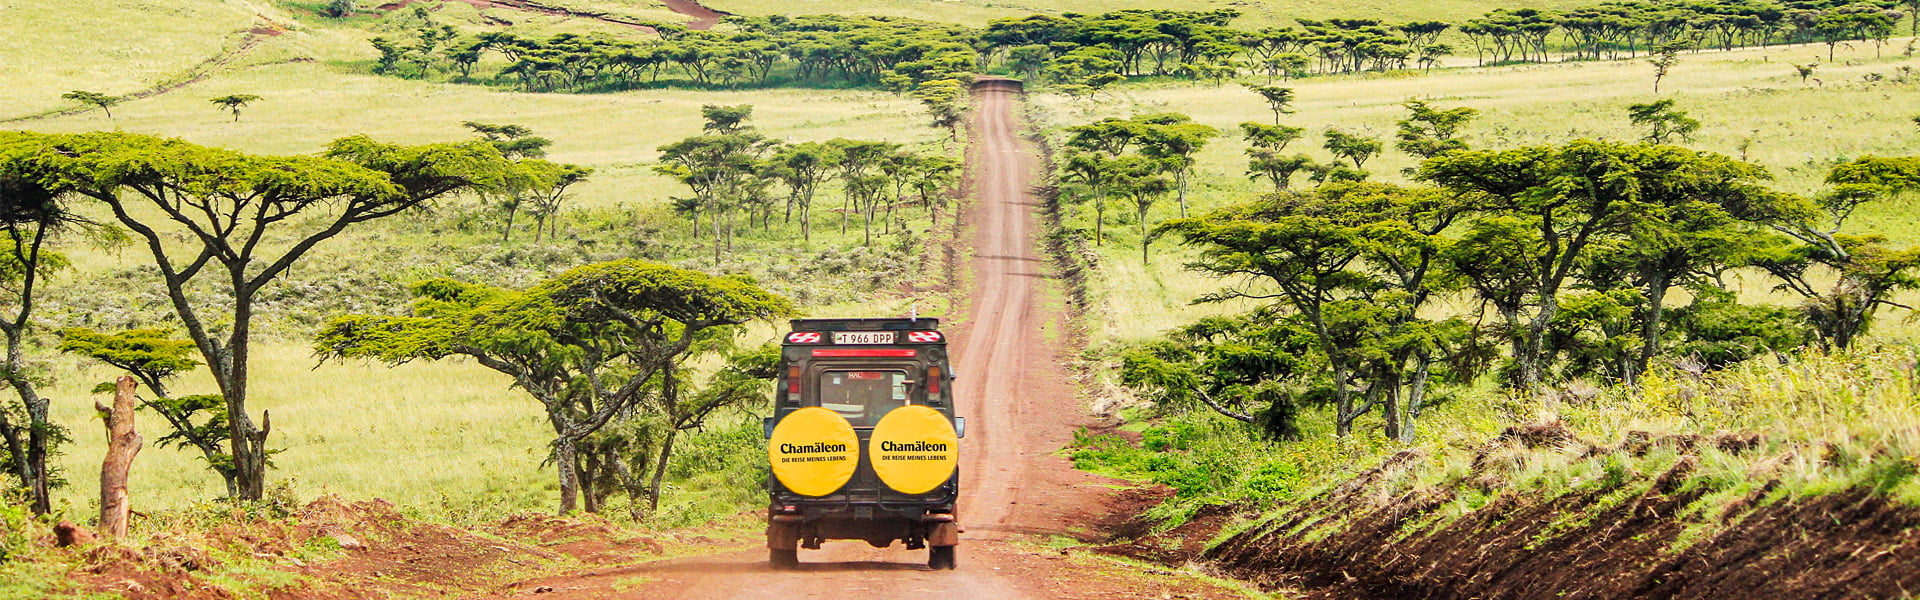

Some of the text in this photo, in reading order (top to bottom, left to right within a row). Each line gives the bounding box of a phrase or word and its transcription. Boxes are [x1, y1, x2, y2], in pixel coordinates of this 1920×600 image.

[842, 334, 892, 343] T 966 DPP
[780, 442, 846, 454] Chamäleon
[881, 441, 947, 452] Chamäleon
